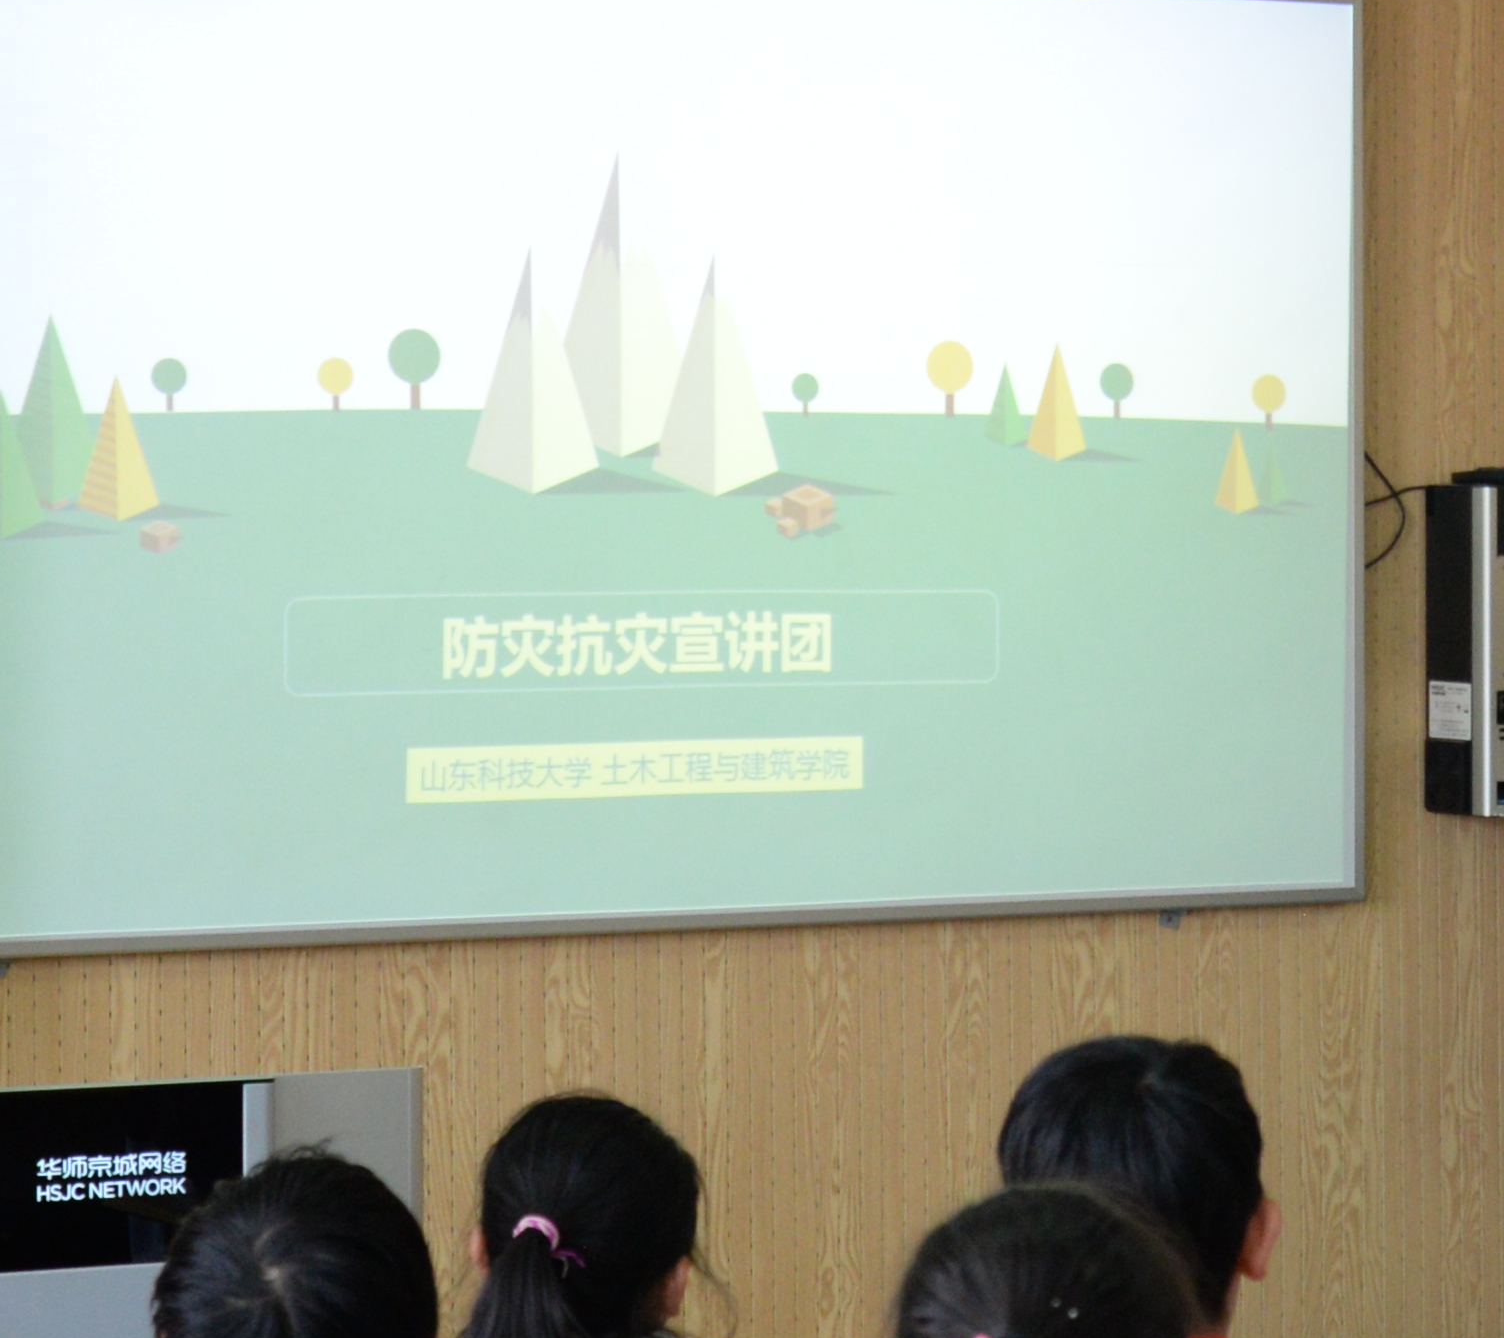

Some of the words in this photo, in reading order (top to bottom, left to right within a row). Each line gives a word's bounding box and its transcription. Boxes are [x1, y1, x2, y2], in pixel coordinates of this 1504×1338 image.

[442, 611, 832, 679] 防灾抗灾宣讲团
[419, 758, 592, 793] 山东科技大学
[601, 749, 850, 786] 土木工程与建筑学院
[37, 1150, 186, 1180] 华师京城网络
[36, 1183, 86, 1202] HSJC
[88, 1177, 187, 1200] NETWORK
